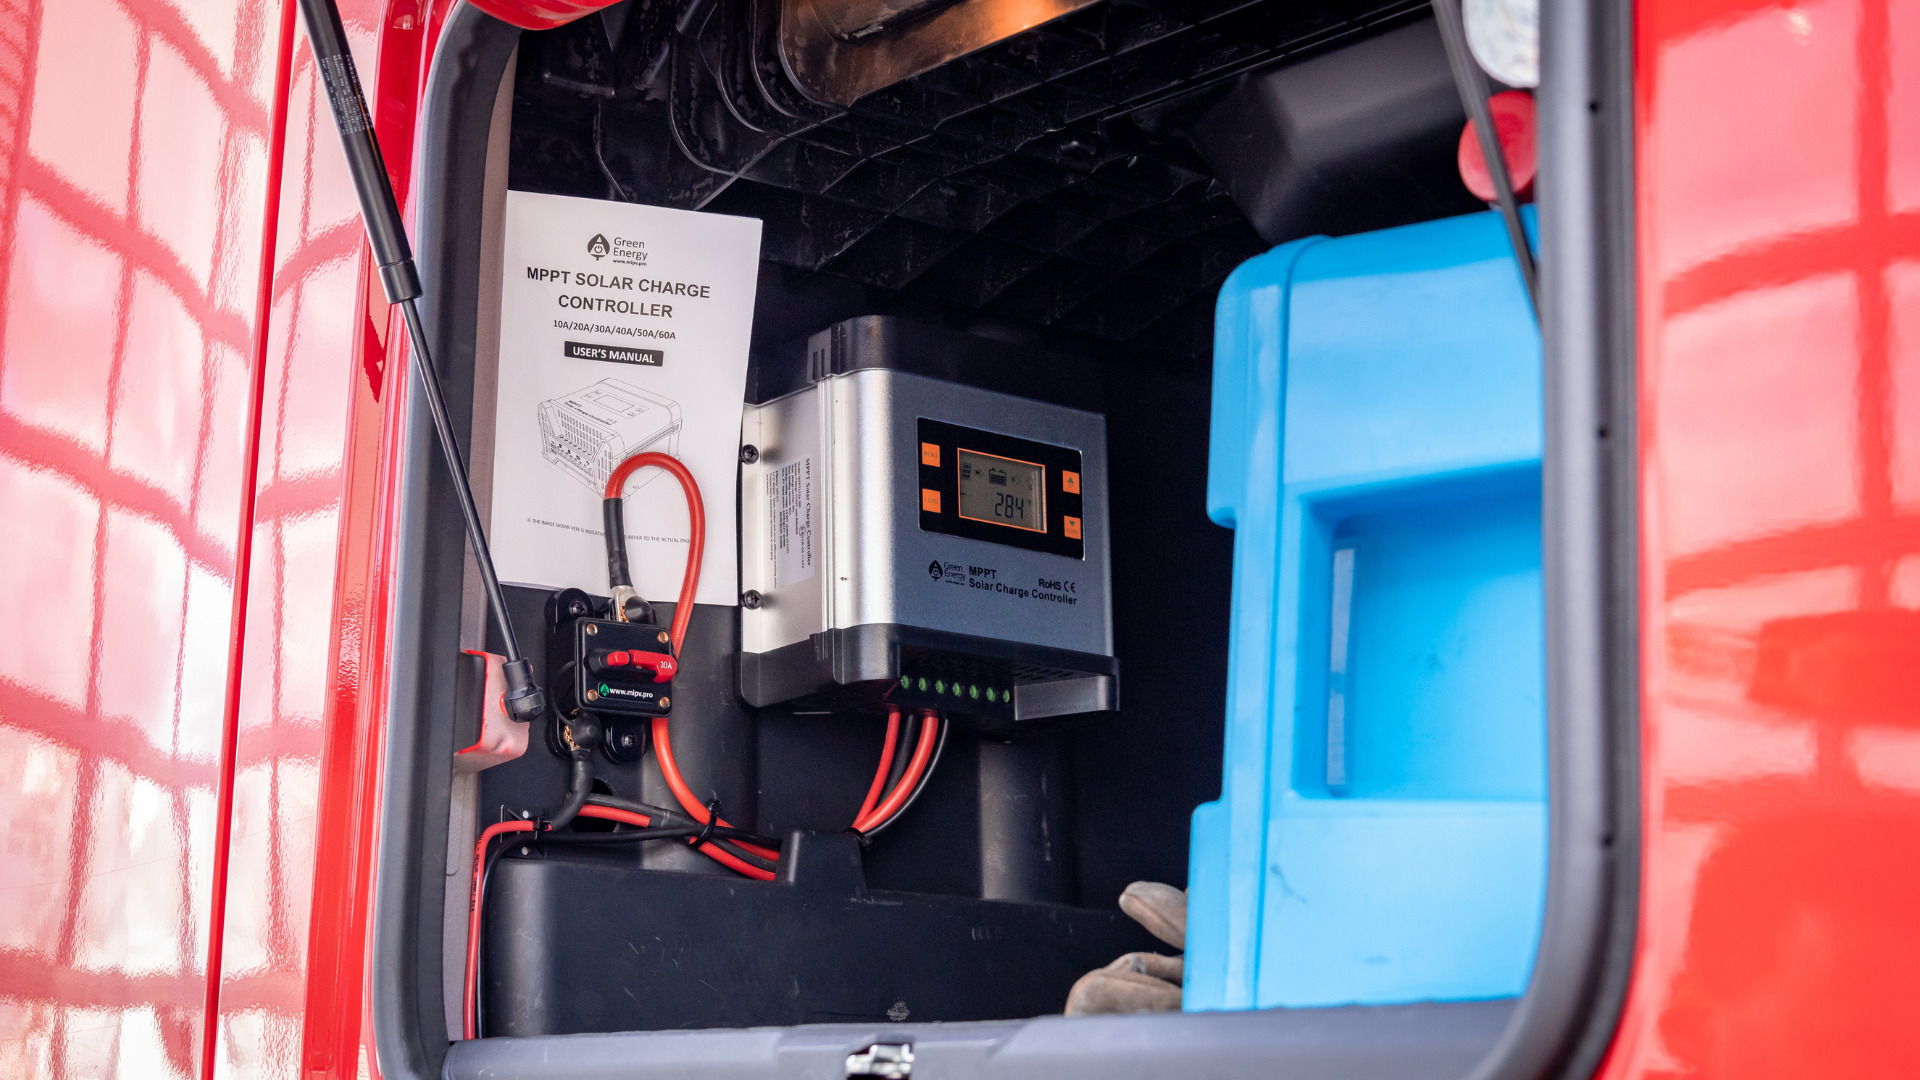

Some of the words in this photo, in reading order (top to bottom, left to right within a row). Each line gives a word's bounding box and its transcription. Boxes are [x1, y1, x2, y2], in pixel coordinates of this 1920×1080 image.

[613, 237, 645, 248] Green
[613, 247, 648, 261] Energy
[612, 259, 647, 267] www.mipv.pro
[527, 267, 571, 284] MPPT
[575, 272, 633, 290] SOLAR
[638, 279, 711, 299] CHARGE
[558, 295, 673, 318] CONTROLLER
[553, 320, 676, 340] 10A/20A/30A/40A/50A/60A
[573, 346, 607, 361] USER'S
[609, 350, 655, 364] MANUAL
[555, 522, 570, 530] SHOWN
[944, 562, 963, 572] Green
[969, 565, 997, 580] MPPT
[944, 570, 966, 582] Energy
[1038, 578, 1062, 591] RoHS
[968, 578, 994, 591] Solar
[996, 583, 1029, 599] Charge
[1031, 589, 1077, 605] Controller
[660, 660, 673, 670] 30A
[609, 687, 653, 699] www.mipv.pro
